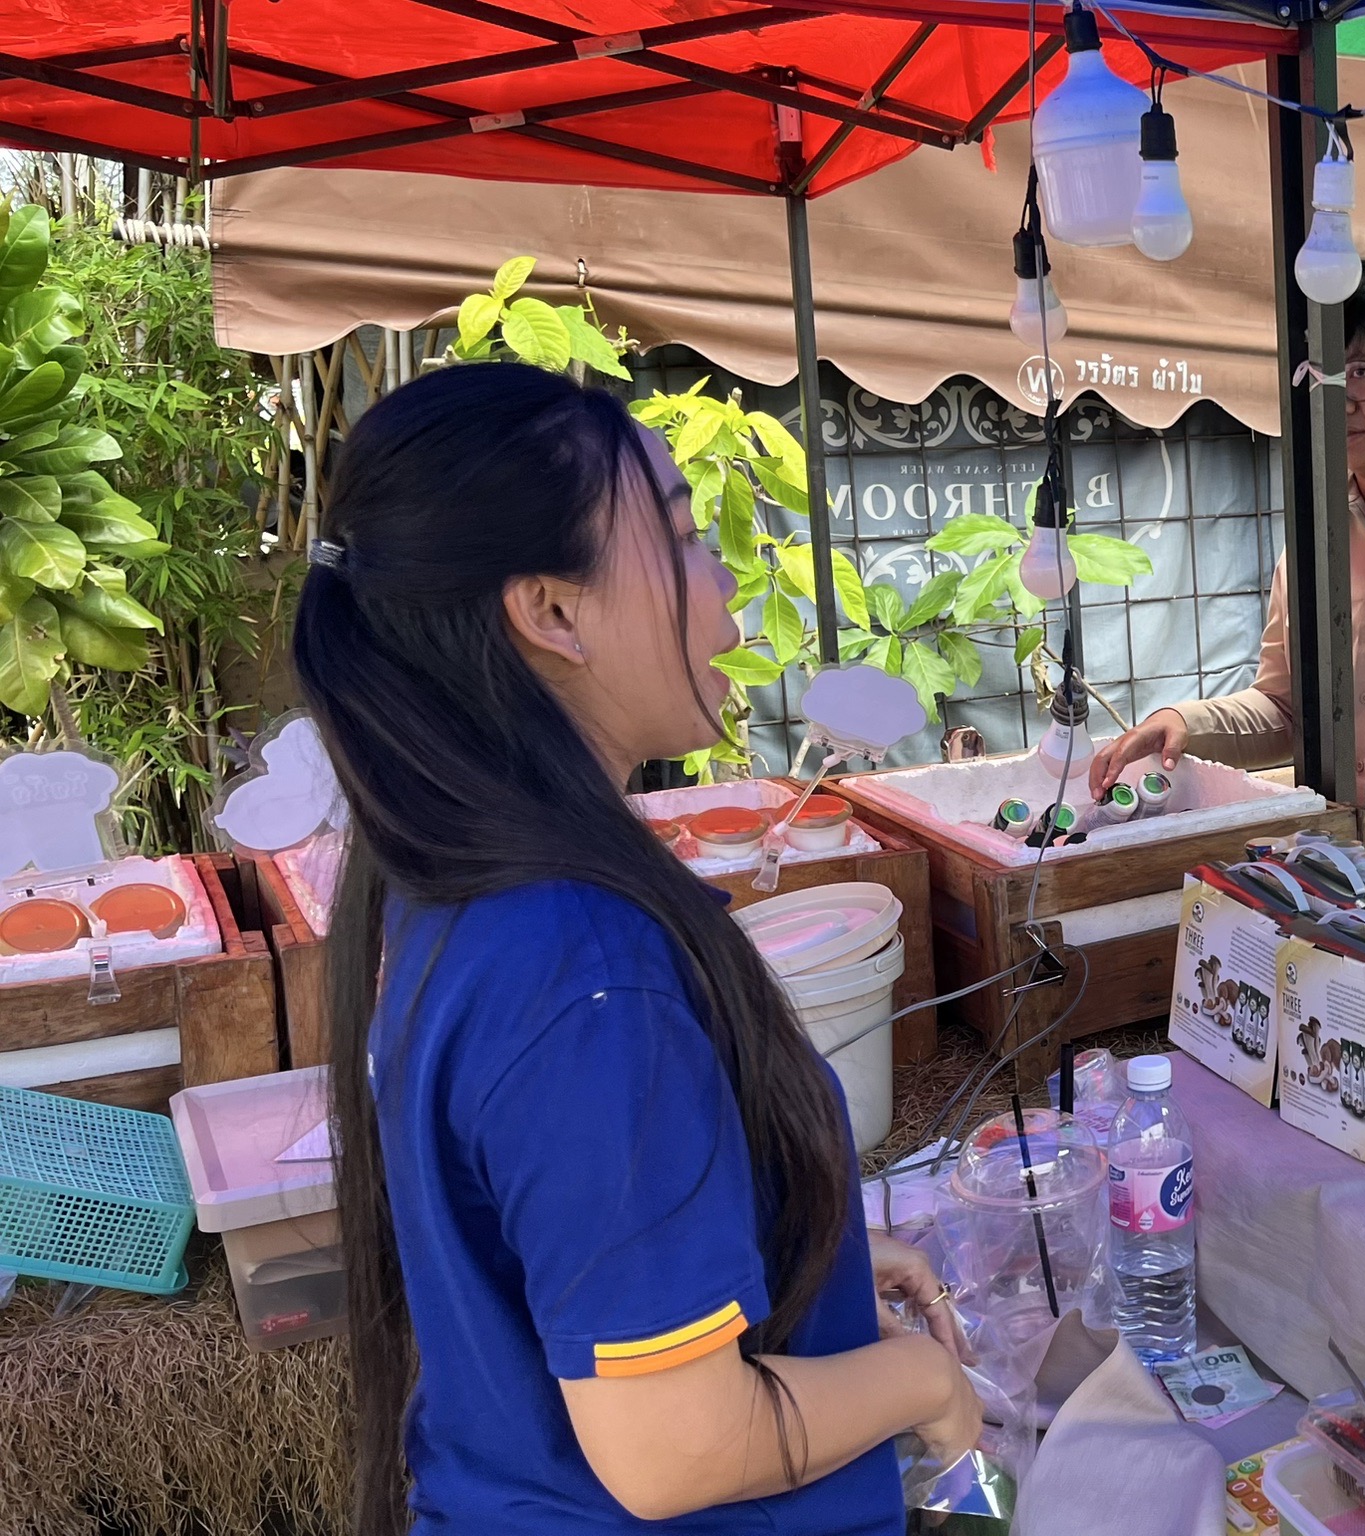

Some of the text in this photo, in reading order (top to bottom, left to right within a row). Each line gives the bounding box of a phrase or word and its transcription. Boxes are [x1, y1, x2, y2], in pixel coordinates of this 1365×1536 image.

[1152, 357, 1202, 394] ผ้าใบ
[1185, 927, 1204, 950] THREE
[1282, 992, 1301, 1013] THREE
